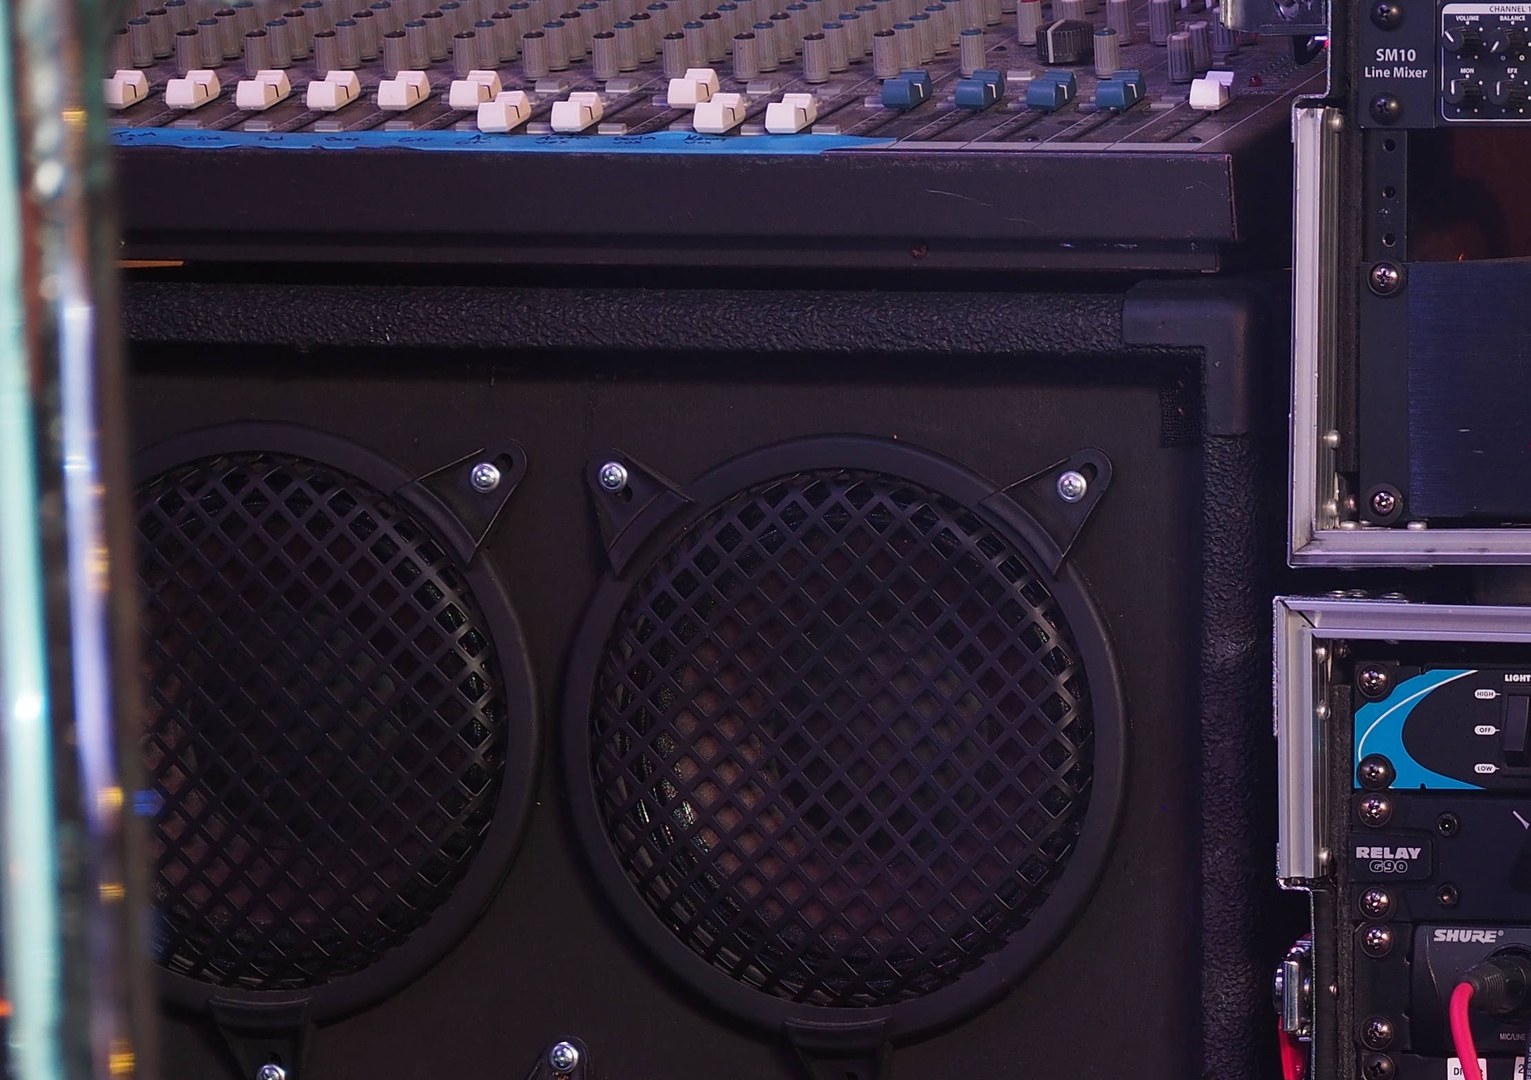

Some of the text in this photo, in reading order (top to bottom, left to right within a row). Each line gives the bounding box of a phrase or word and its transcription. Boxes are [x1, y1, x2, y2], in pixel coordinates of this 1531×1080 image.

[1376, 48, 1416, 62] SM10
[1365, 67, 1428, 79] Line Mixer
[1356, 846, 1421, 859] RELAY
[1369, 860, 1407, 873] G90
[1433, 929, 1497, 944] SHURE
